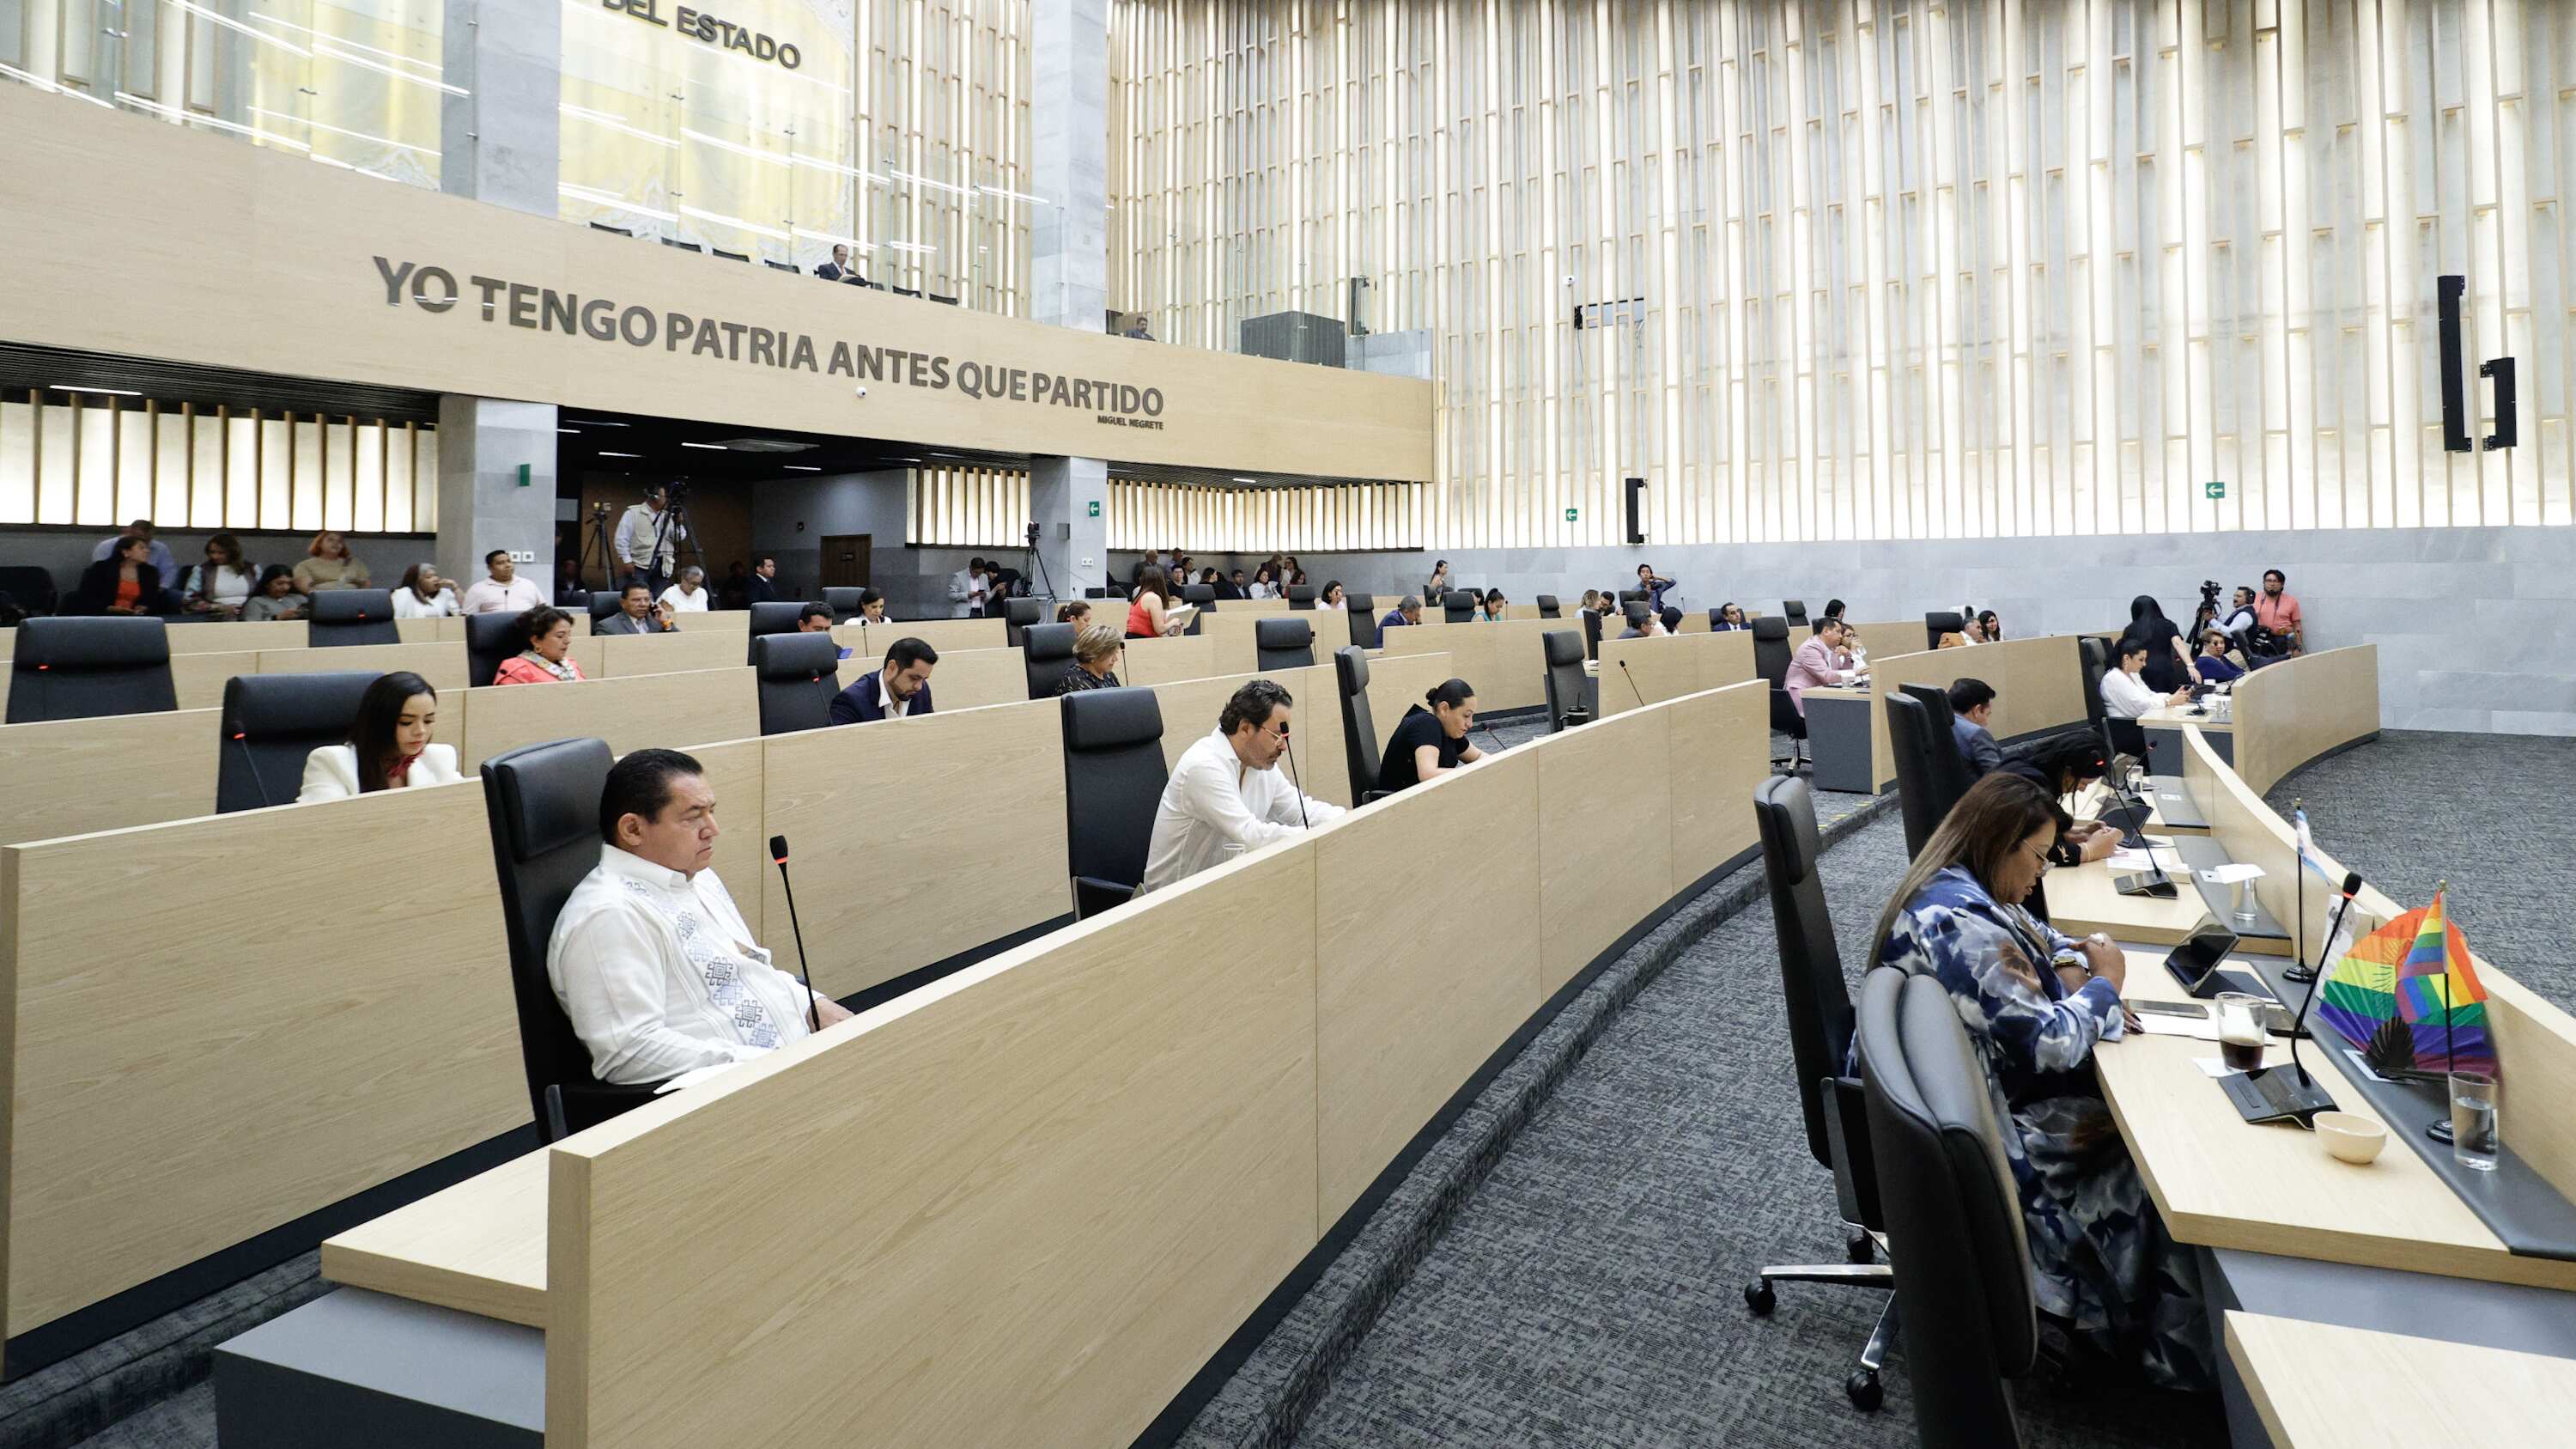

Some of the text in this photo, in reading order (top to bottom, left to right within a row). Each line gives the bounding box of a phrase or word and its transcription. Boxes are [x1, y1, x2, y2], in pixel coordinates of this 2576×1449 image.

[677, 6, 800, 69] ESTADO
[373, 256, 1163, 416] YO TENGO PATRIA ANTES QUE PARTIDO
[1097, 415, 1163, 429] MIGUEL NEGRETE
